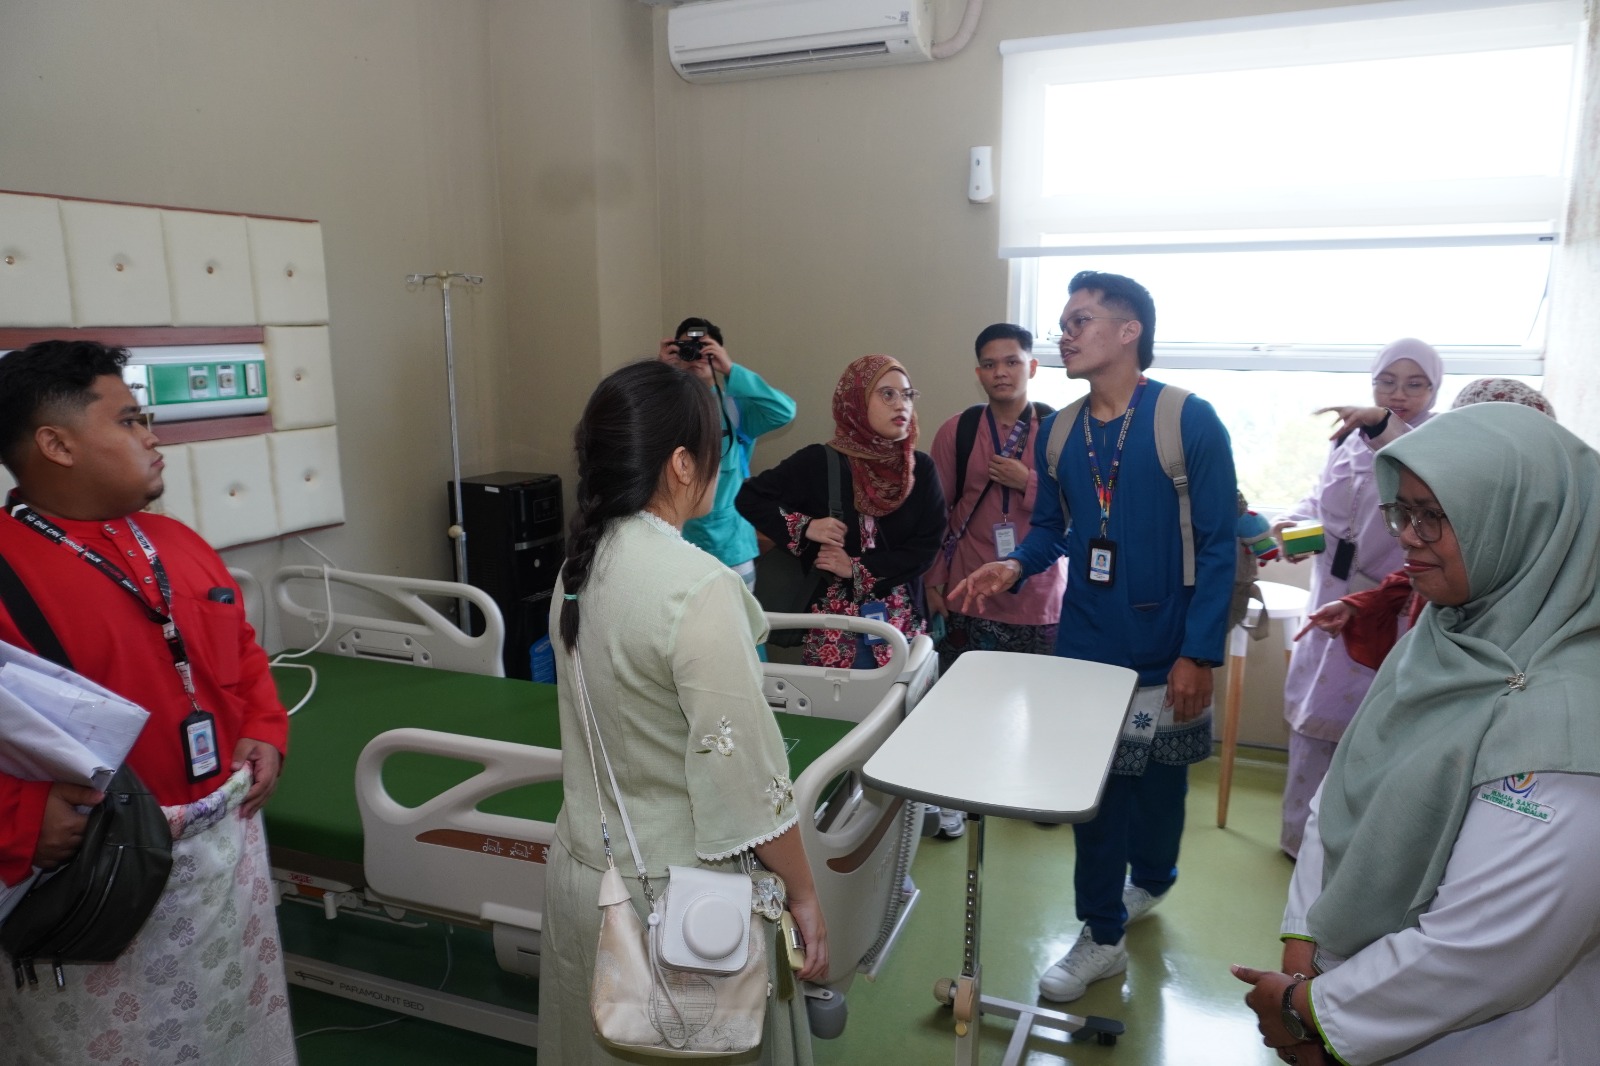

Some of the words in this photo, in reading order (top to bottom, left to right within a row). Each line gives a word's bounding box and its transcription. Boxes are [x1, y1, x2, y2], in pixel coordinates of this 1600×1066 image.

[25, 514, 36, 522] NO
[34, 520, 48, 530] ONE
[46, 528, 61, 538] CAN
[60, 536, 84, 553] CHANGE
[84, 551, 102, 563] YOUR
[1481, 793, 1514, 809] UNIVERSITAS
[1516, 806, 1548, 820] ANDALAS
[1491, 790, 1513, 802] RUMAH
[1515, 799, 1541, 811] SAKIT
[340, 982, 401, 1005] PARAMOUNT
[403, 999, 425, 1012] BED
